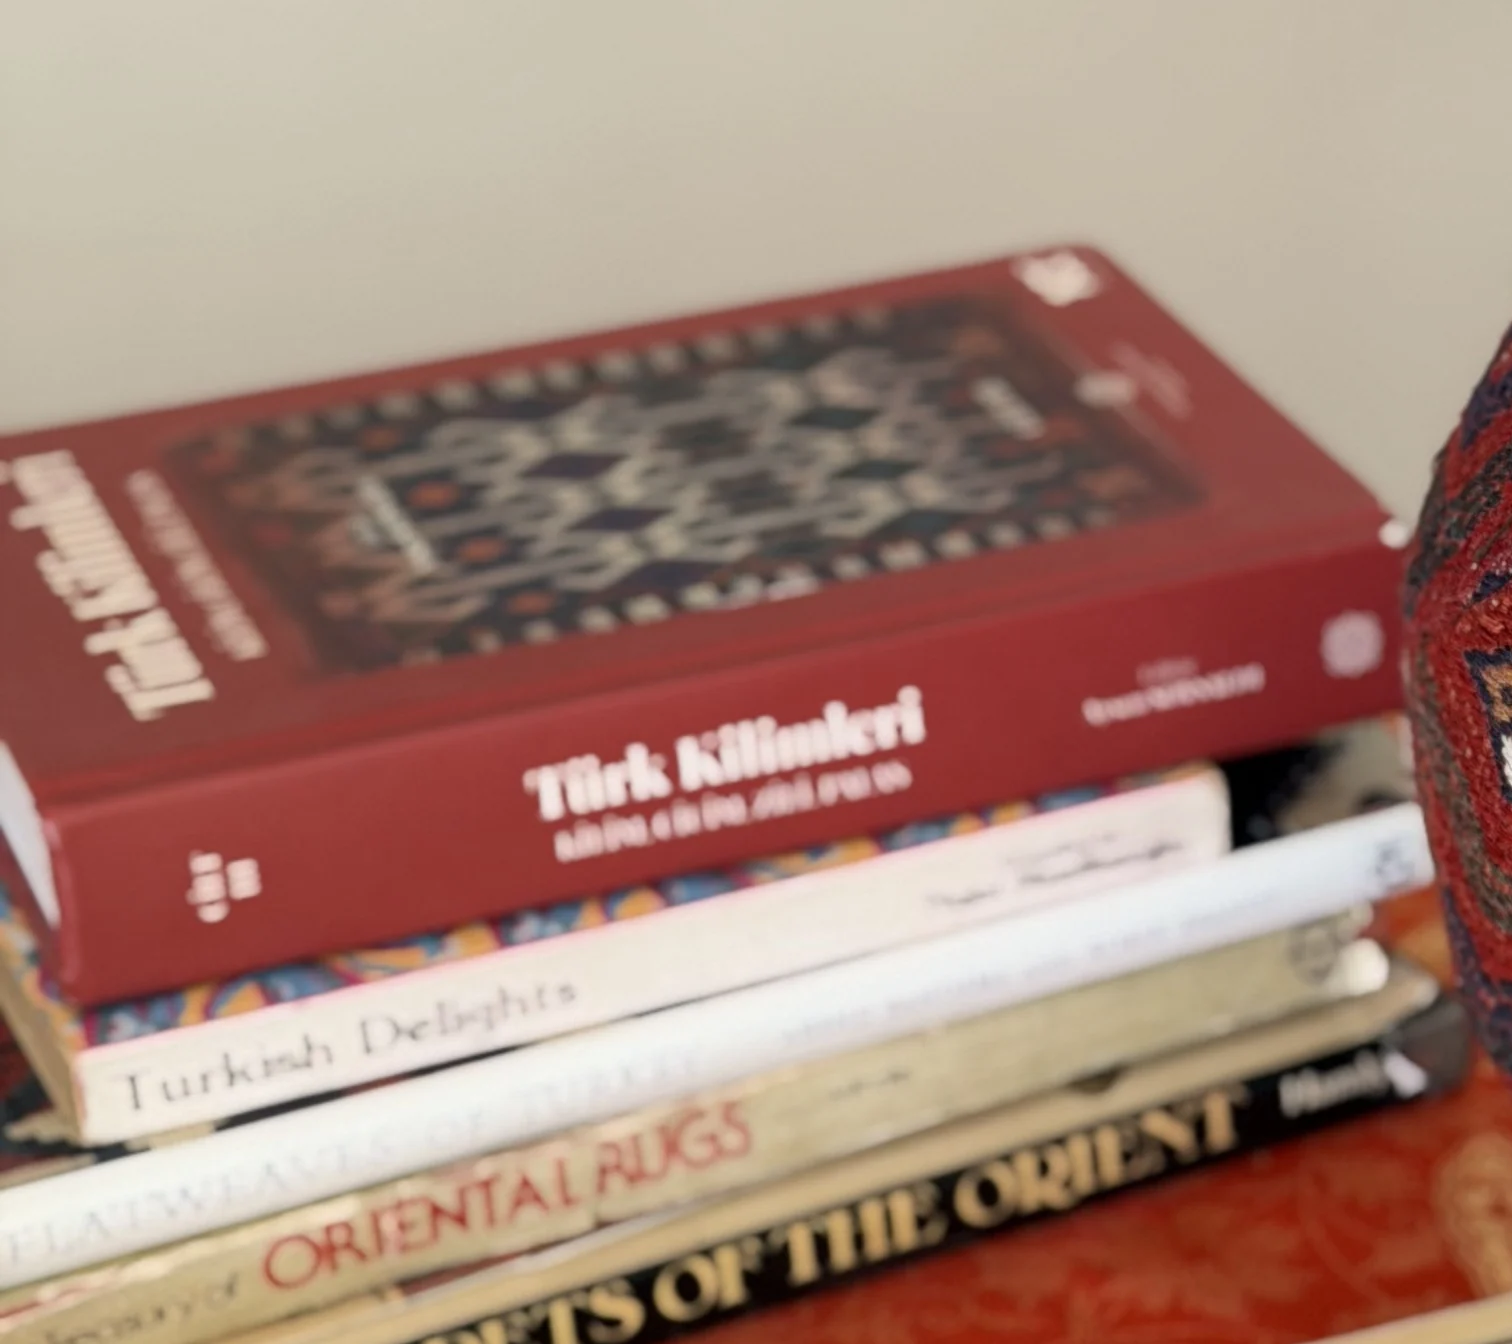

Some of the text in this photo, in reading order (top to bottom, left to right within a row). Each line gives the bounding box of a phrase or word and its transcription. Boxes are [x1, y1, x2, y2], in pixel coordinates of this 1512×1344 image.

[522, 740, 673, 823] Türk
[674, 684, 927, 793] Kilimleri
[124, 980, 579, 1112] Turkish Delights
[261, 1156, 581, 1293] ORIENTAL
[596, 1100, 754, 1197] RUGS
[651, 1244, 768, 1323] OF
[780, 1176, 948, 1288] THE
[952, 1081, 1250, 1228] ORIENT
